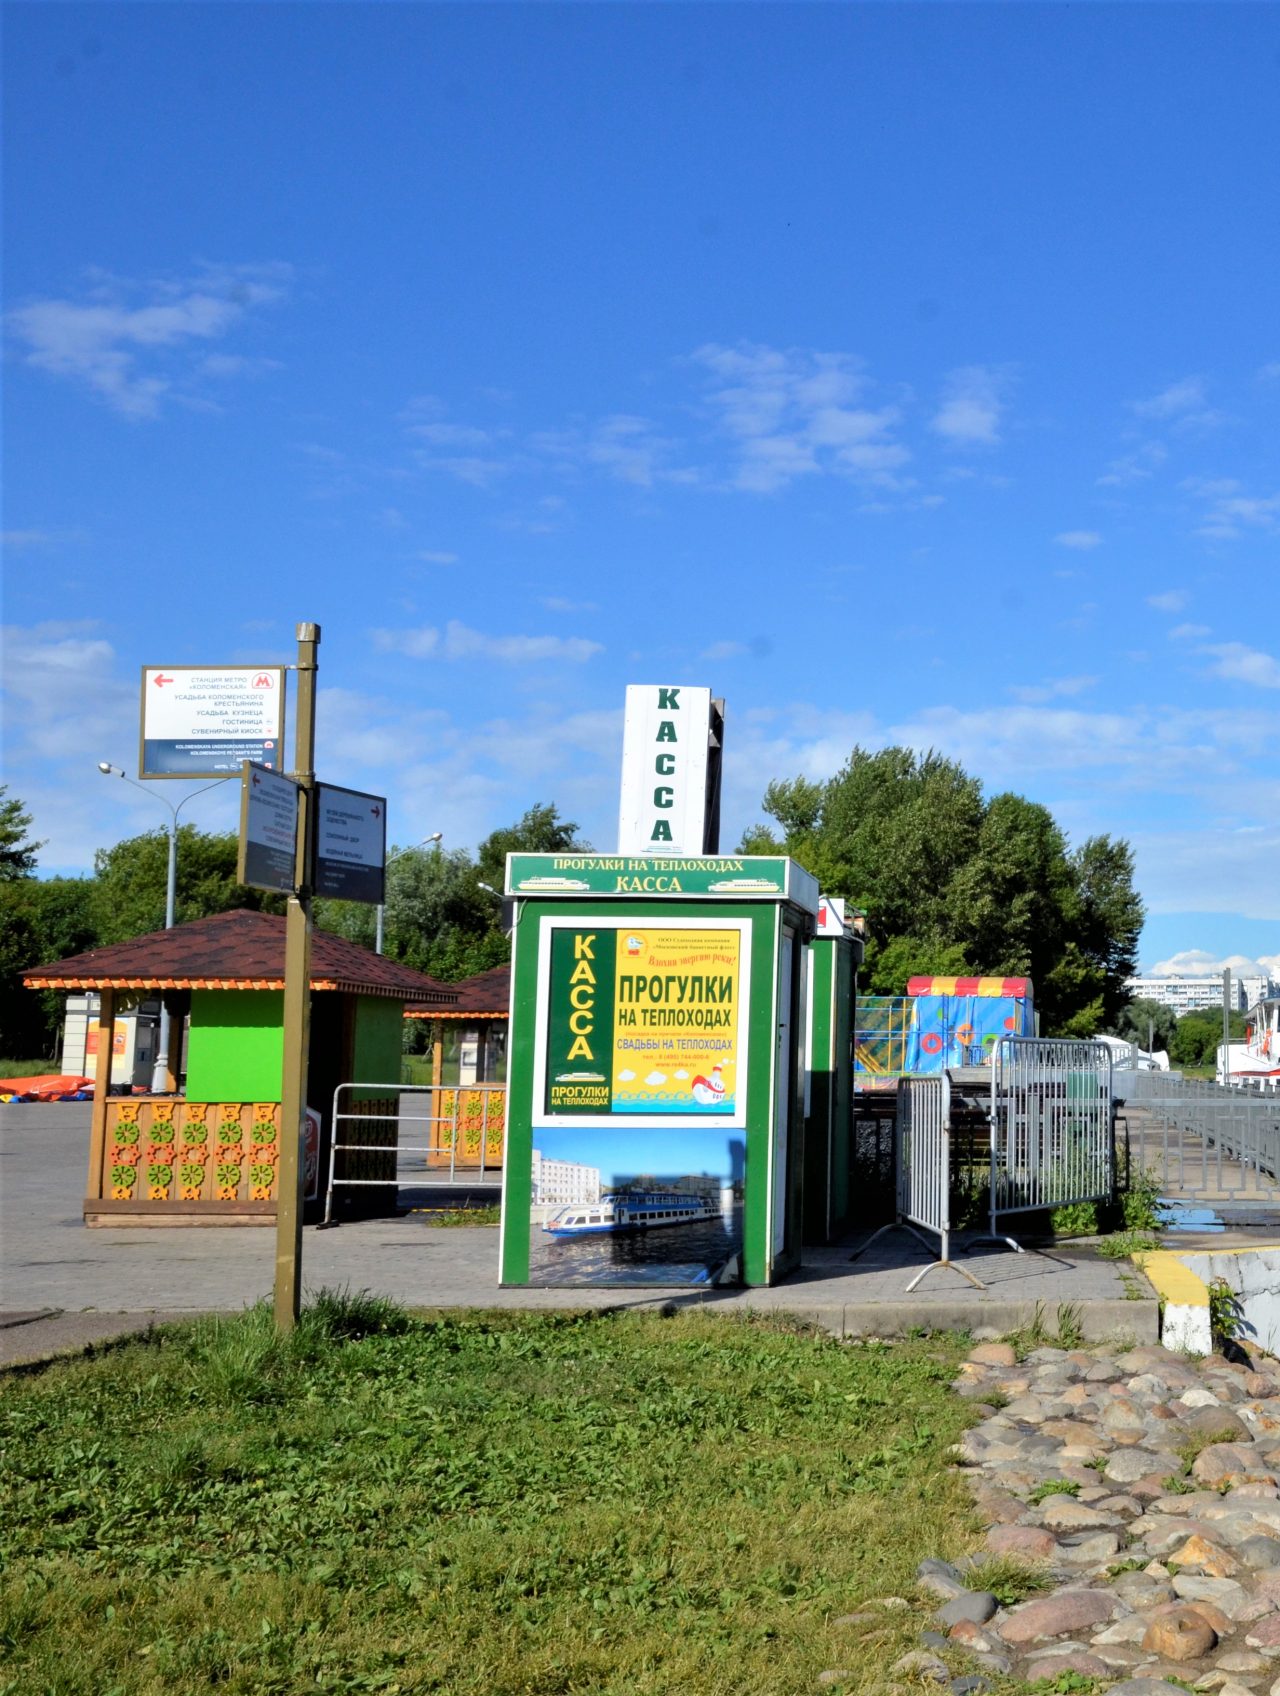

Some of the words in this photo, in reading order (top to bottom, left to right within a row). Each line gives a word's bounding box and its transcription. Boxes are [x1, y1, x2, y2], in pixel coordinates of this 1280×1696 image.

[650, 688, 680, 842] КАССА
[553, 858, 625, 870] ПРОГУЛКИ
[628, 860, 648, 871] НА
[652, 860, 744, 873] ТЕПЛОХОДАХ
[616, 876, 682, 892] КАССА
[648, 955, 677, 967] Вдохни
[680, 953, 711, 966] энергию
[712, 953, 737, 966] реки!
[619, 975, 733, 1003] ПРОГУЛКИ
[566, 934, 596, 1060] КАССА
[618, 1009, 637, 1026] НА
[641, 1009, 731, 1030] ТЕПЛОХОДАХ
[617, 1038, 660, 1051] СВАДЬБЫ
[662, 1040, 674, 1049] НА
[677, 1040, 733, 1051] ТЕПЛОХОДАХ
[552, 1086, 609, 1098] ПРОГУЛКИ
[563, 1098, 608, 1106] ТЕПЛОХОДАХ
